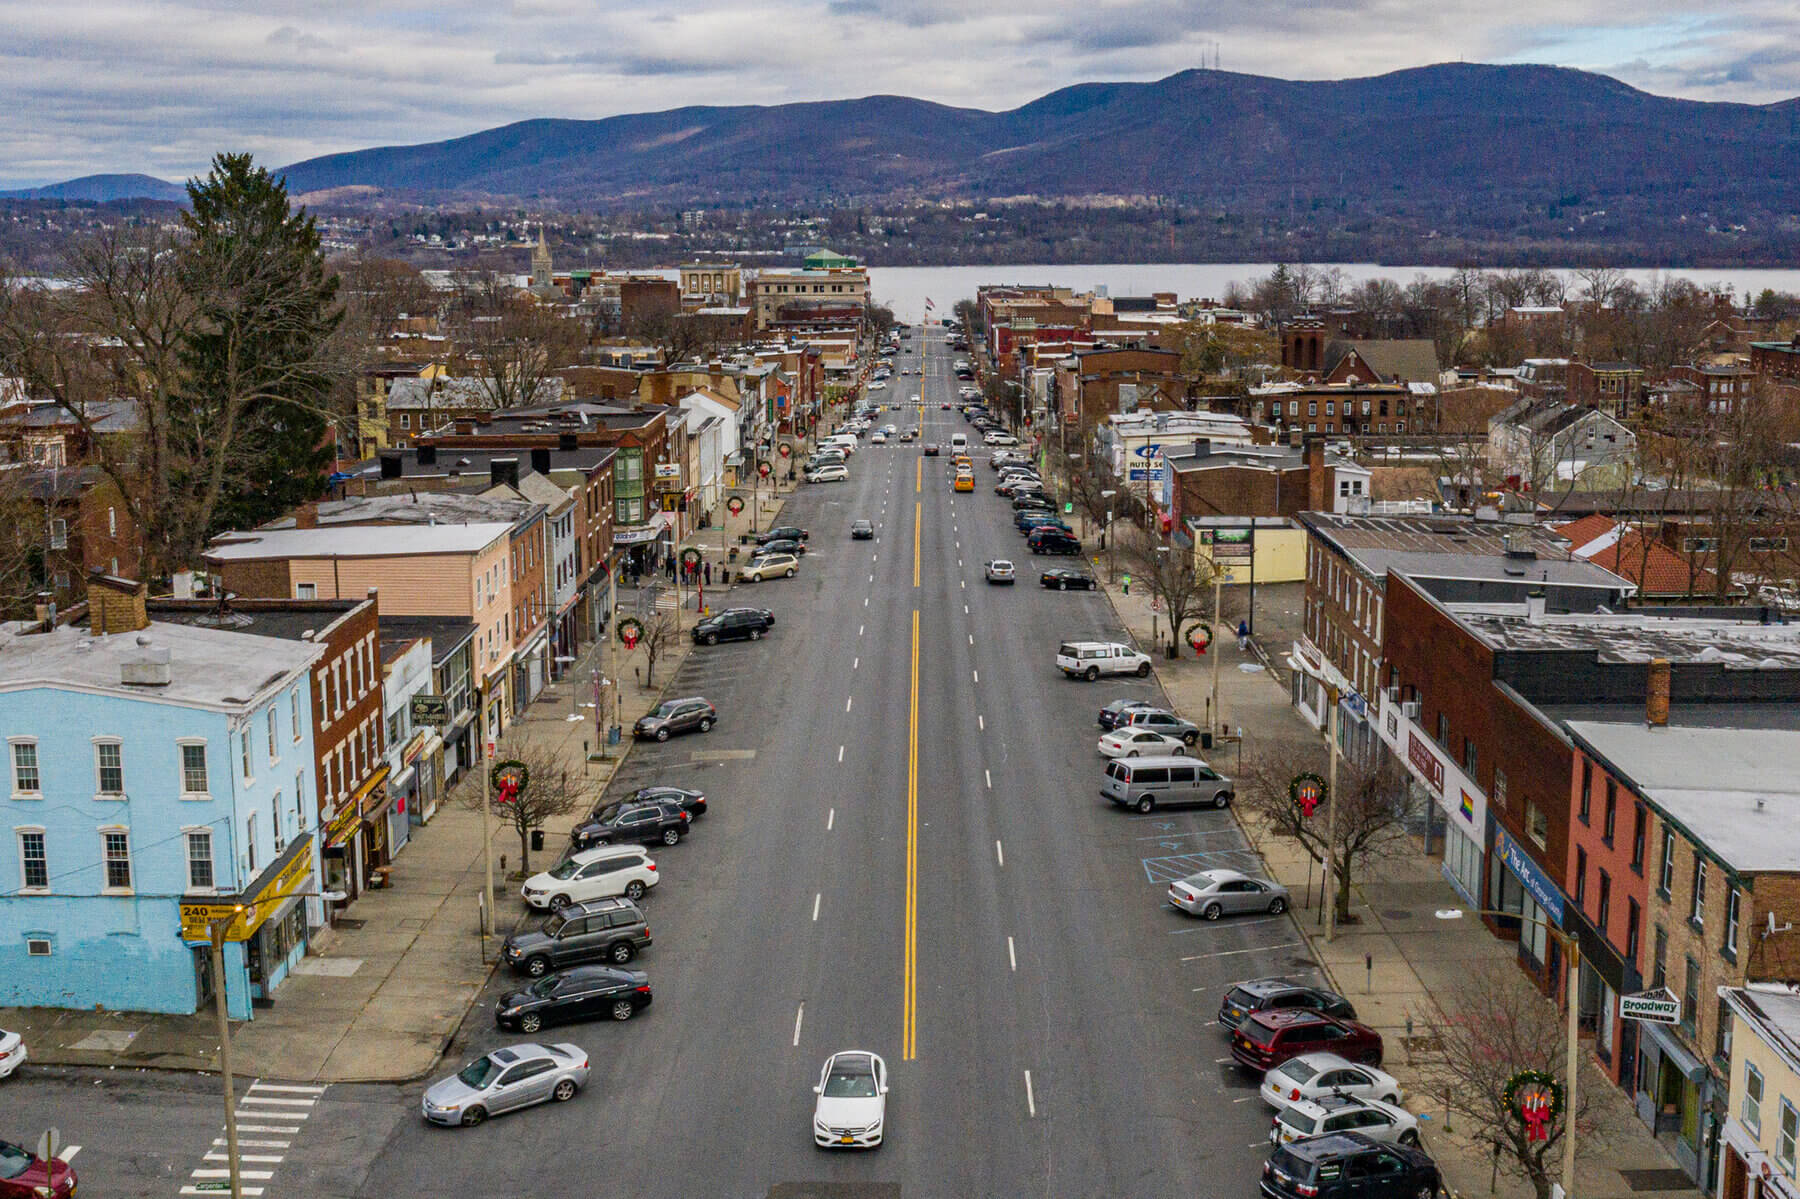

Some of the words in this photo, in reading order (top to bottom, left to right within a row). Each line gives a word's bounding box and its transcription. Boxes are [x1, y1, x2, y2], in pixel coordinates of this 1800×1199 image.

[1511, 847, 1520, 872] The
[1521, 861, 1530, 883] Arc
[184, 907, 208, 916] 240
[1623, 1000, 1677, 1013] Broadway
